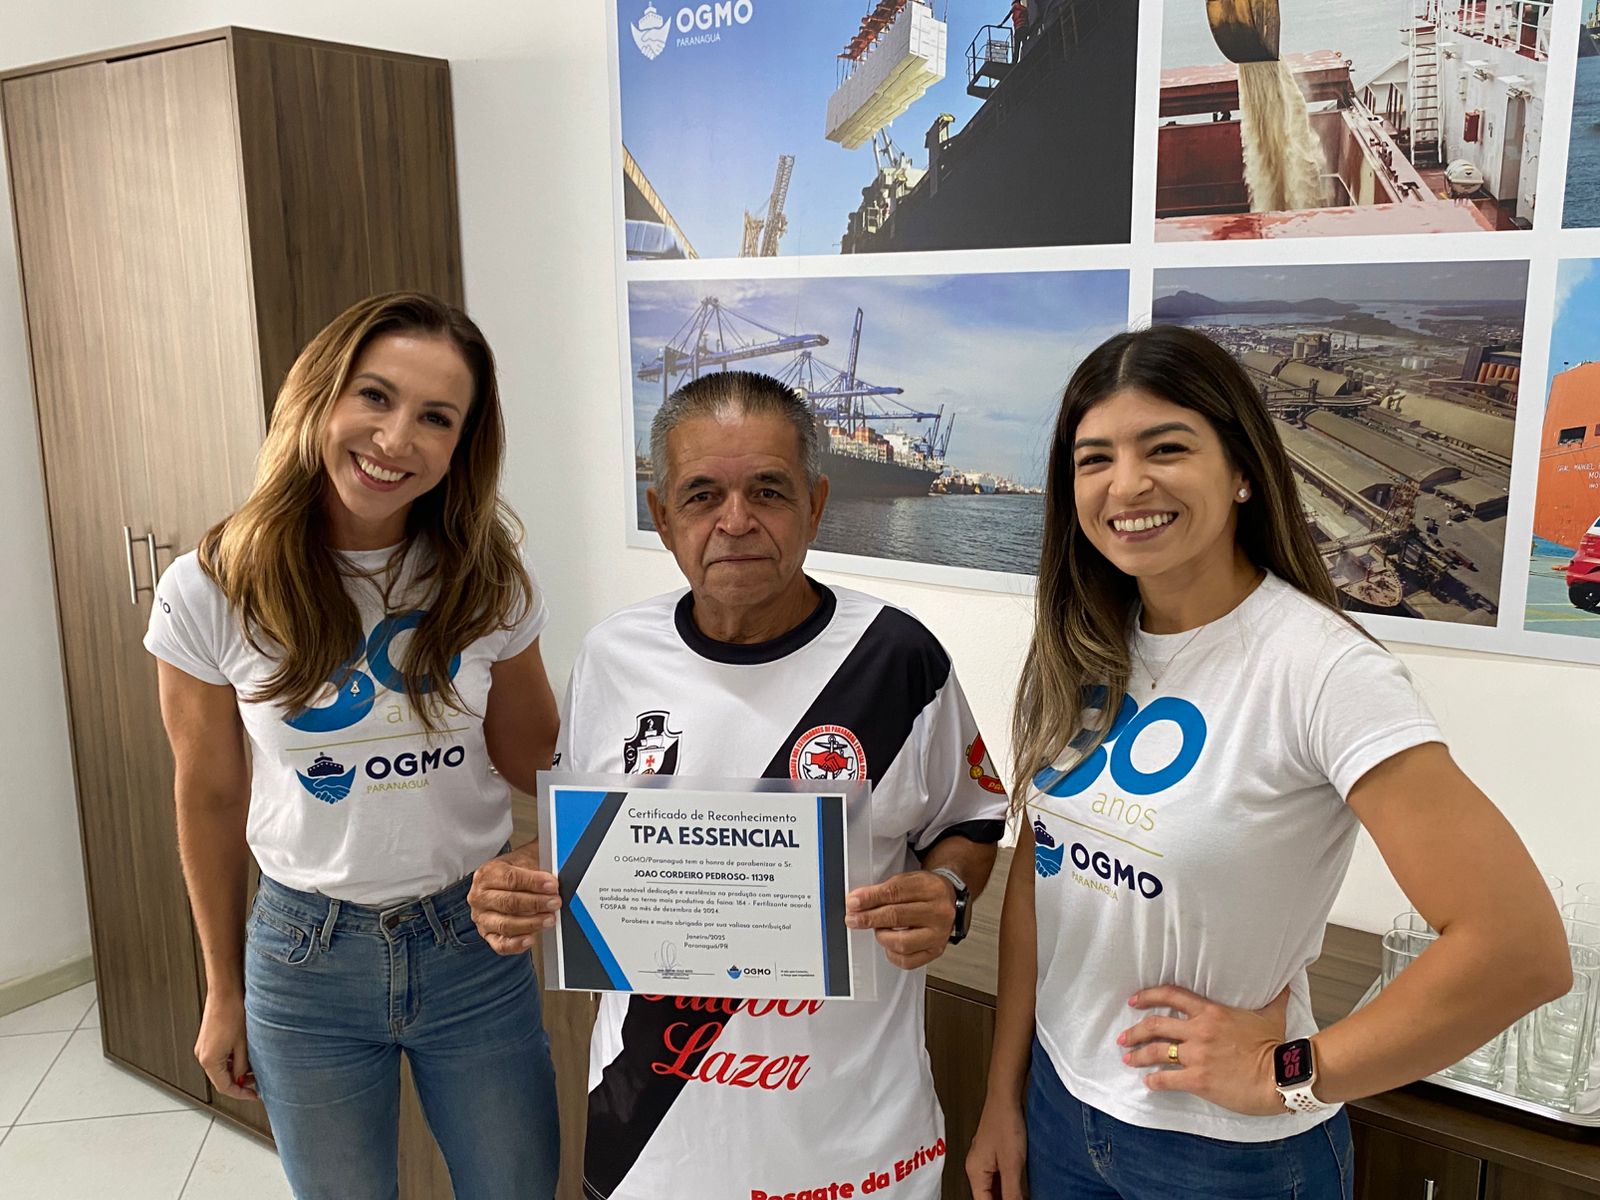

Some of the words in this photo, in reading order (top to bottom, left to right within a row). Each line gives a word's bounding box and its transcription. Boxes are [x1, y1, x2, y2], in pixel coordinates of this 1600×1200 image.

[676, 0, 753, 33] OGMO
[365, 746, 465, 780] OGMO
[628, 808, 687, 821] Certificado
[690, 810, 704, 821] de
[708, 810, 797, 823] Reconhecimento
[1091, 792, 1158, 832] anos
[630, 825, 673, 844] TPA
[679, 826, 800, 848] ESSENCIAL
[737, 859, 776, 868] parabenizar
[1070, 842, 1164, 900] OGMO
[660, 870, 704, 880] CORDEIRO
[706, 872, 750, 882] PEDROSO-
[752, 873, 775, 882] 11398
[599, 895, 630, 903] qualidade
[752, 900, 788, 908] Fertilizante
[647, 887, 678, 896] dedicação
[728, 889, 757, 898] produção
[773, 892, 806, 901] segurança
[621, 917, 650, 925] Parabéns
[675, 919, 703, 928] obrigado
[743, 967, 772, 976] OGMO
[652, 1022, 811, 1091] Lazer
[861, 1172, 890, 1194] da
